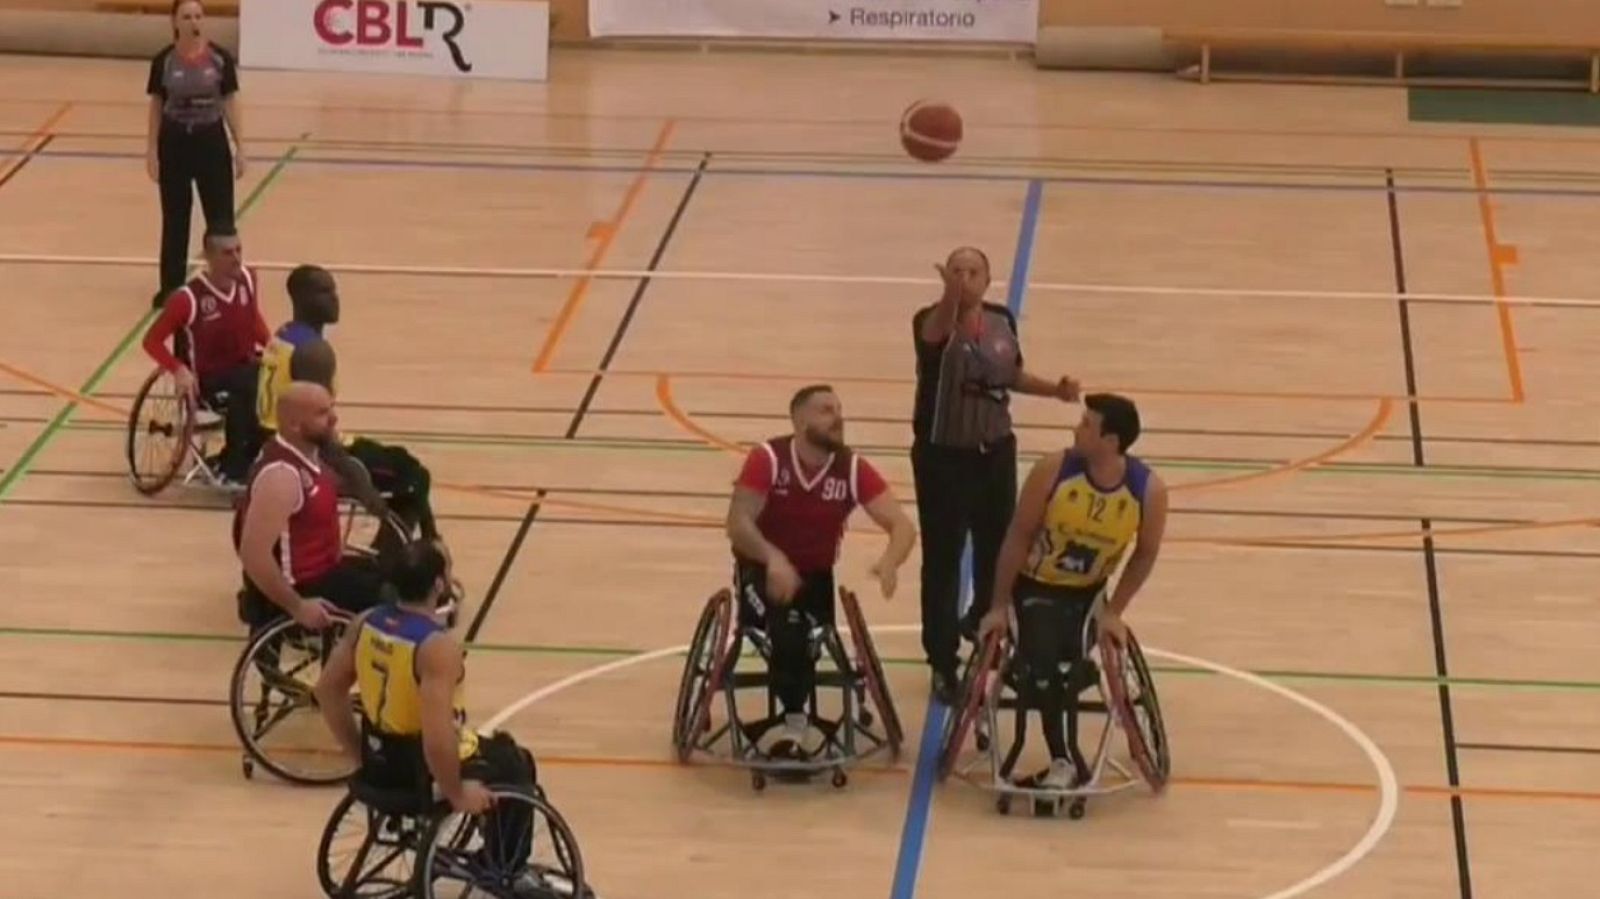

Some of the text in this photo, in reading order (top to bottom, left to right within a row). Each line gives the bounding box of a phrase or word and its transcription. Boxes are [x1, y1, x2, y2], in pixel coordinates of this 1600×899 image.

[850, 8, 976, 29] Respiratorio
[822, 477, 848, 501] 90
[1086, 492, 1108, 523] 12
[370, 660, 390, 729] 7
